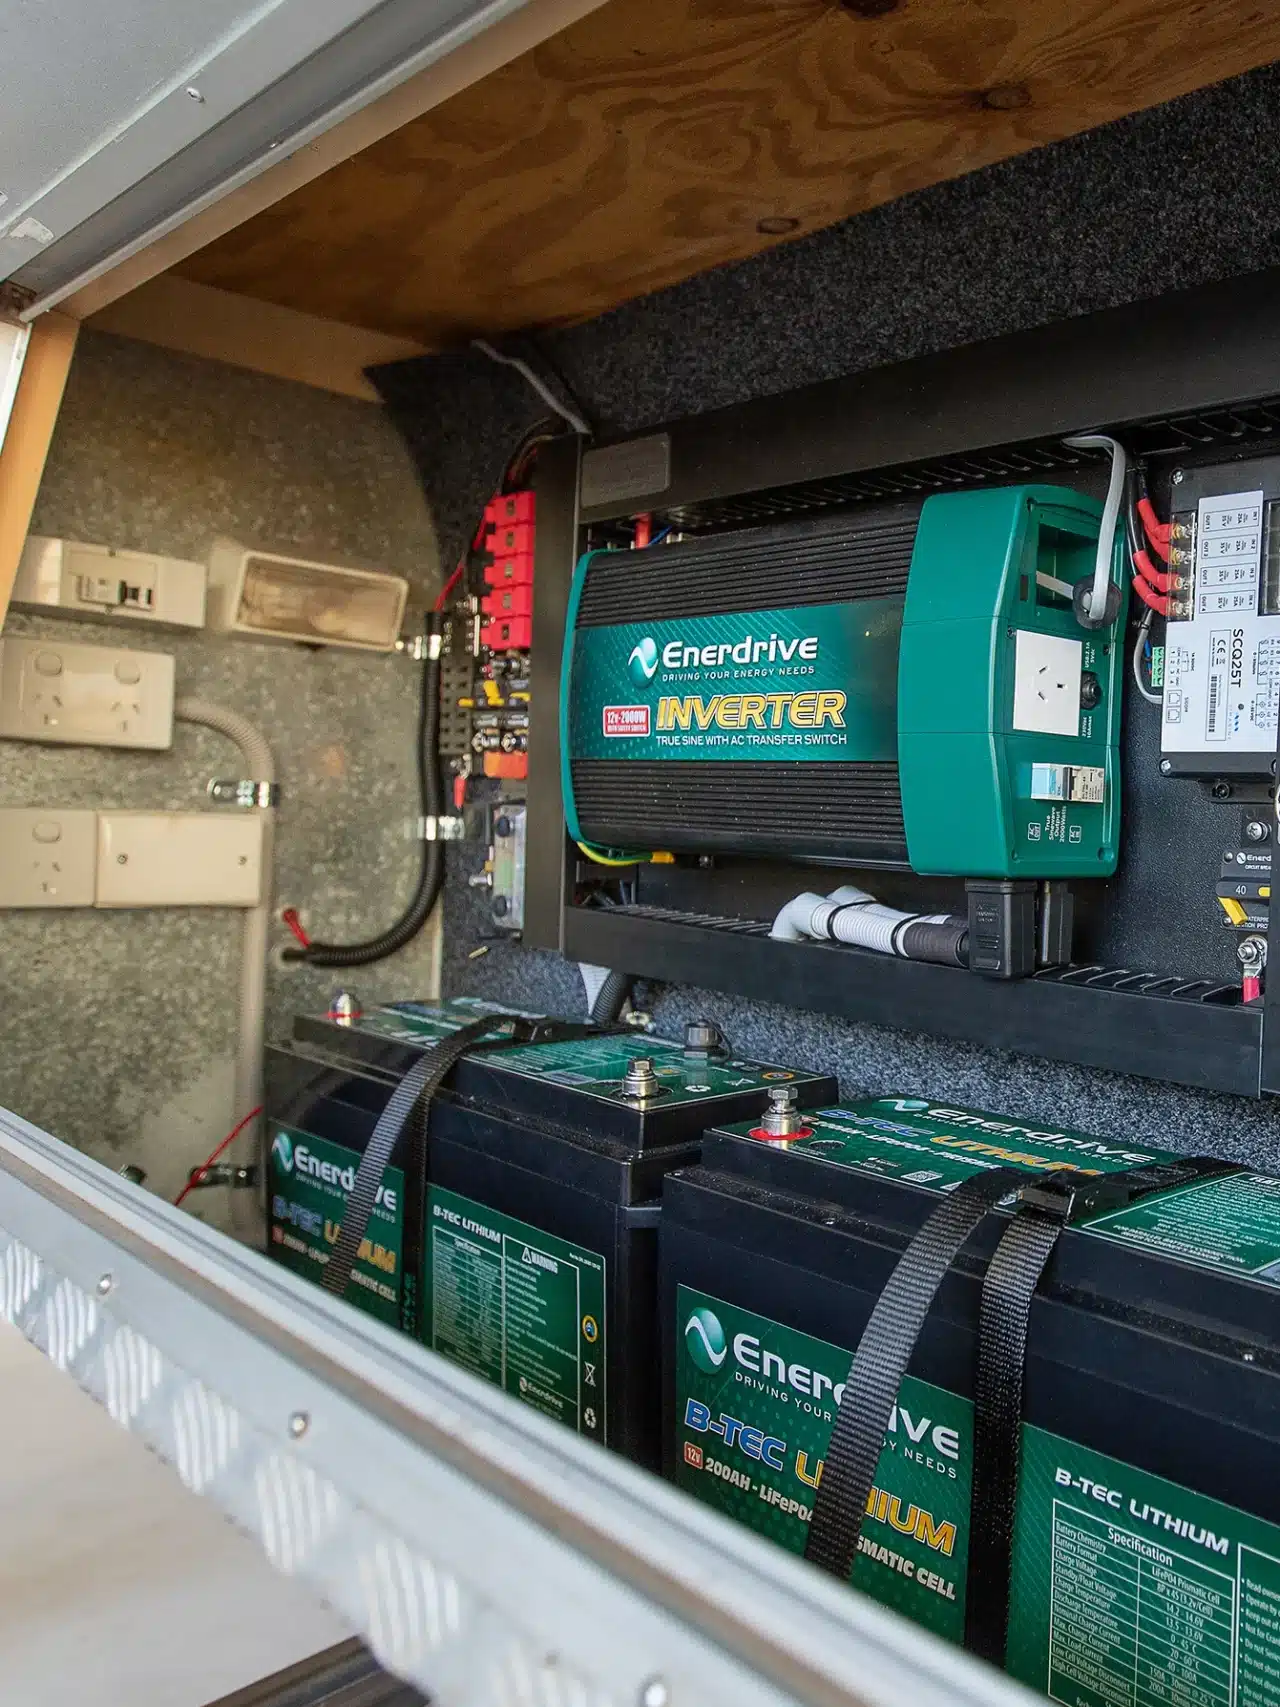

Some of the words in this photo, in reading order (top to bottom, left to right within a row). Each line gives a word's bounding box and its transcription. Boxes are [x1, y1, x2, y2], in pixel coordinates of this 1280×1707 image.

[662, 634, 818, 669] Enerdrive
[1231, 628, 1244, 688] SCQ25T
[662, 672, 701, 682] DRIVING
[704, 670, 730, 680] YOUR
[733, 668, 775, 679] ENERGY
[778, 665, 815, 676] NEEDS
[655, 690, 847, 731] INVERTER
[656, 736, 681, 746] TRUE
[682, 735, 704, 746] SINE
[705, 735, 729, 745] WITH
[731, 735, 745, 745] AC
[746, 734, 802, 745] TRANSFER
[804, 734, 847, 745] SWITCH
[1048, 806, 1056, 840] Sinewave
[1059, 805, 1067, 842] 2000Watts
[1235, 885, 1247, 895] 40
[815, 1108, 936, 1138] B-TEC
[913, 1113, 968, 1129] DRIVING
[927, 1108, 1157, 1162] Enerdrive
[1249, 1176, 1280, 1189] FLAT
[433, 1205, 461, 1226] B-TEC
[462, 1217, 501, 1244] LITHIUM
[531, 1251, 558, 1274] WARNING
[528, 1382, 564, 1409] Enerdrive
[735, 1371, 788, 1402] DRIVING
[795, 1398, 832, 1422] YOUR
[684, 1397, 787, 1472] B-TEC
[1055, 1467, 1122, 1509] B-TEC
[1129, 1498, 1229, 1556] LITHIUM
[705, 1456, 752, 1492] 200AH
[917, 1567, 956, 1602] CELL
[1055, 1522, 1076, 1540] Battery
[1077, 1531, 1107, 1554] Chemistry
[1055, 1536, 1076, 1553] Battery
[1077, 1545, 1098, 1563] Format
[1108, 1527, 1173, 1567] Specification
[1055, 1550, 1075, 1567] Charge
[1075, 1558, 1098, 1577] Voltage
[1054, 1577, 1075, 1594] Charge
[1075, 1585, 1111, 1611] Temperature
[1094, 1580, 1117, 1600] Voltage
[1177, 1577, 1208, 1600] Prismatic
[1207, 1590, 1221, 1606] Cell
[1246, 1579, 1262, 1593] Read
[1054, 1590, 1081, 1612] Discharge
[1082, 1603, 1119, 1630] Temperature
[1165, 1603, 1180, 1616] 14.2
[1245, 1594, 1270, 1612] Operate
[1270, 1605, 1278, 1616] by
[1245, 1607, 1260, 1623] Keep
[1260, 1614, 1272, 1625] out
[1271, 1618, 1279, 1628] of
[1068, 1623, 1089, 1644] Charge
[1079, 1613, 1099, 1632] Charge
[1165, 1617, 1180, 1630] 13.5
